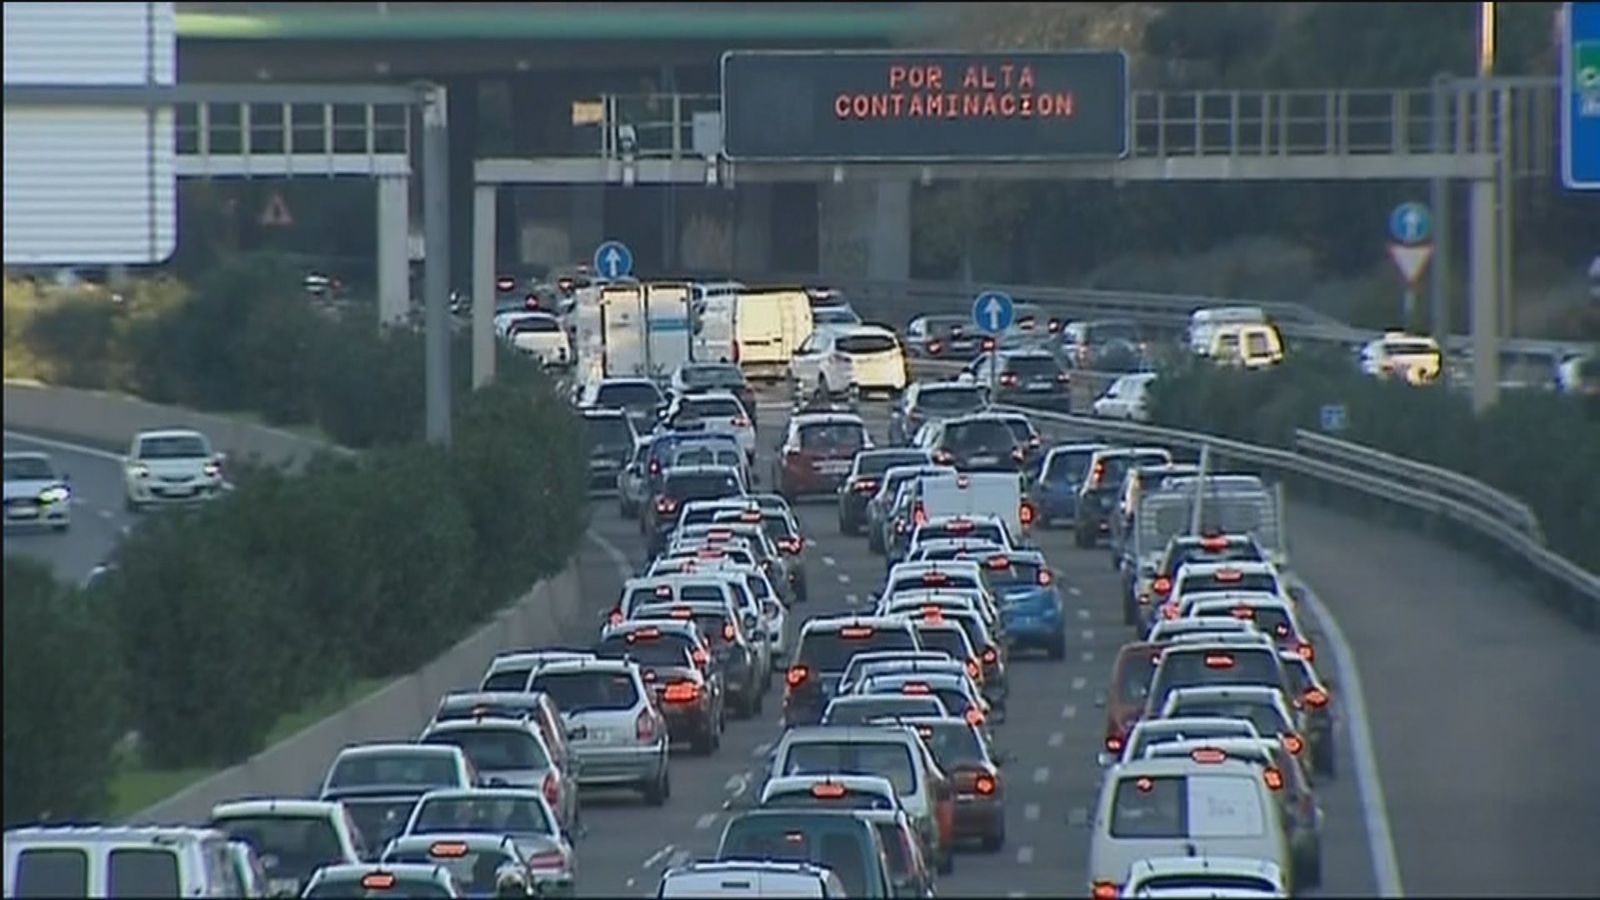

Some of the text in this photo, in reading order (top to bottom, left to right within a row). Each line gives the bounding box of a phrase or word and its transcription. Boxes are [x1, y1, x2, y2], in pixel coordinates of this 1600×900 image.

[890, 65, 1034, 89] POR ALTA
[835, 93, 1073, 117] CONTAMINACION
